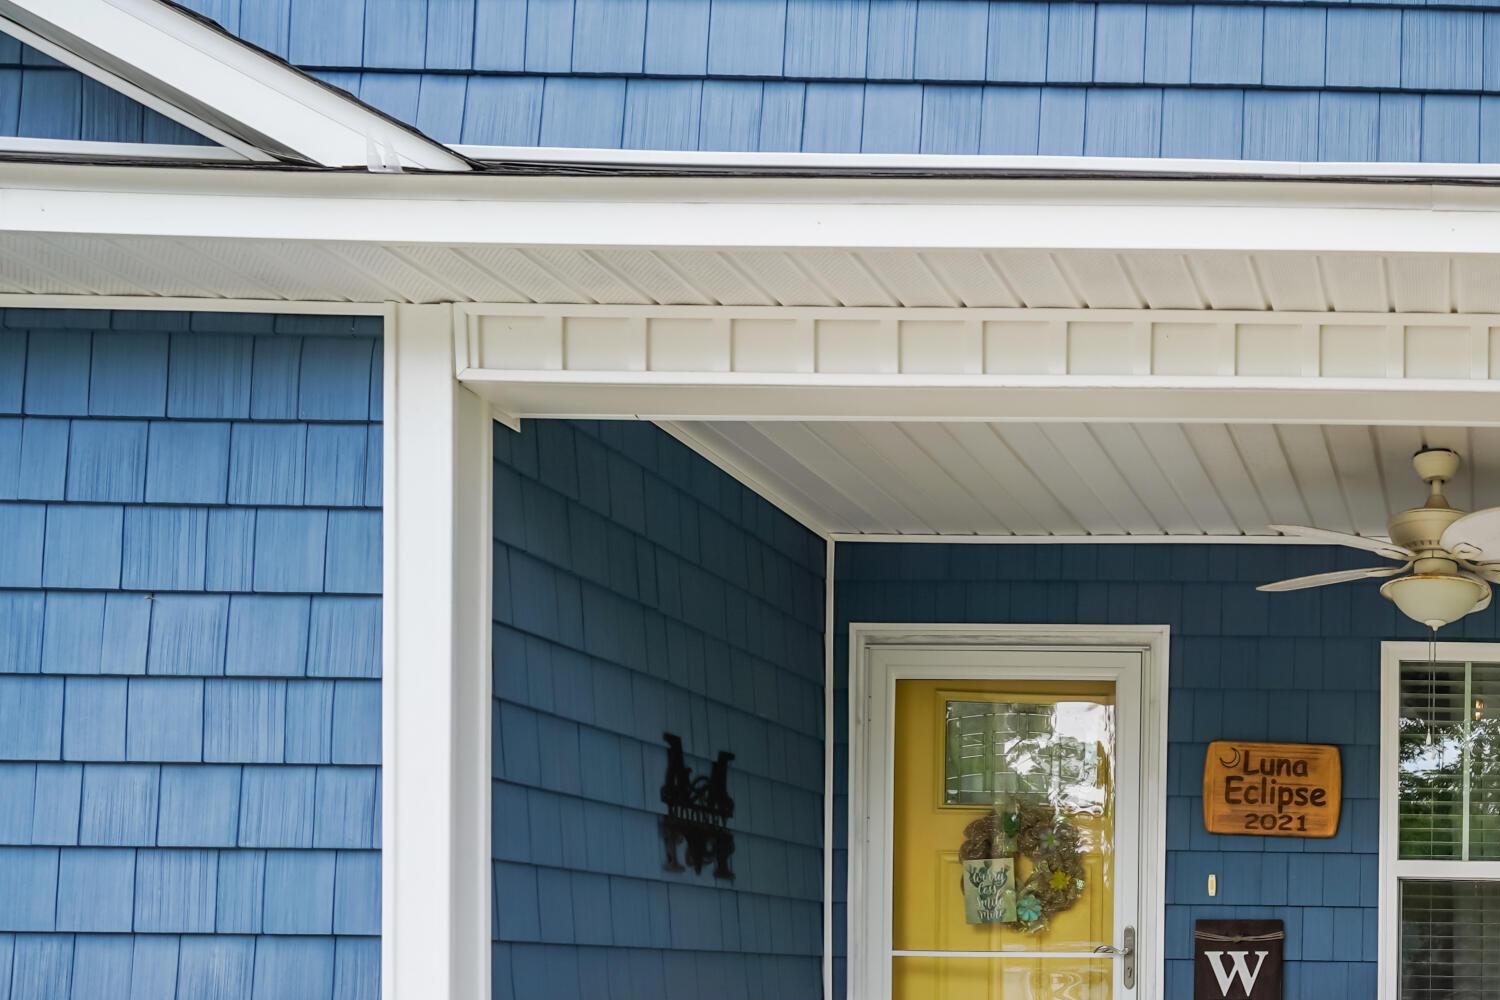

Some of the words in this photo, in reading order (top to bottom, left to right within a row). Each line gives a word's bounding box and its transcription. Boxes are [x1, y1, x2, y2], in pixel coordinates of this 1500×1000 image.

[1243, 750, 1309, 777] Luna
[1225, 775, 1327, 814] Eclipse
[1244, 813, 1308, 832] 2021
